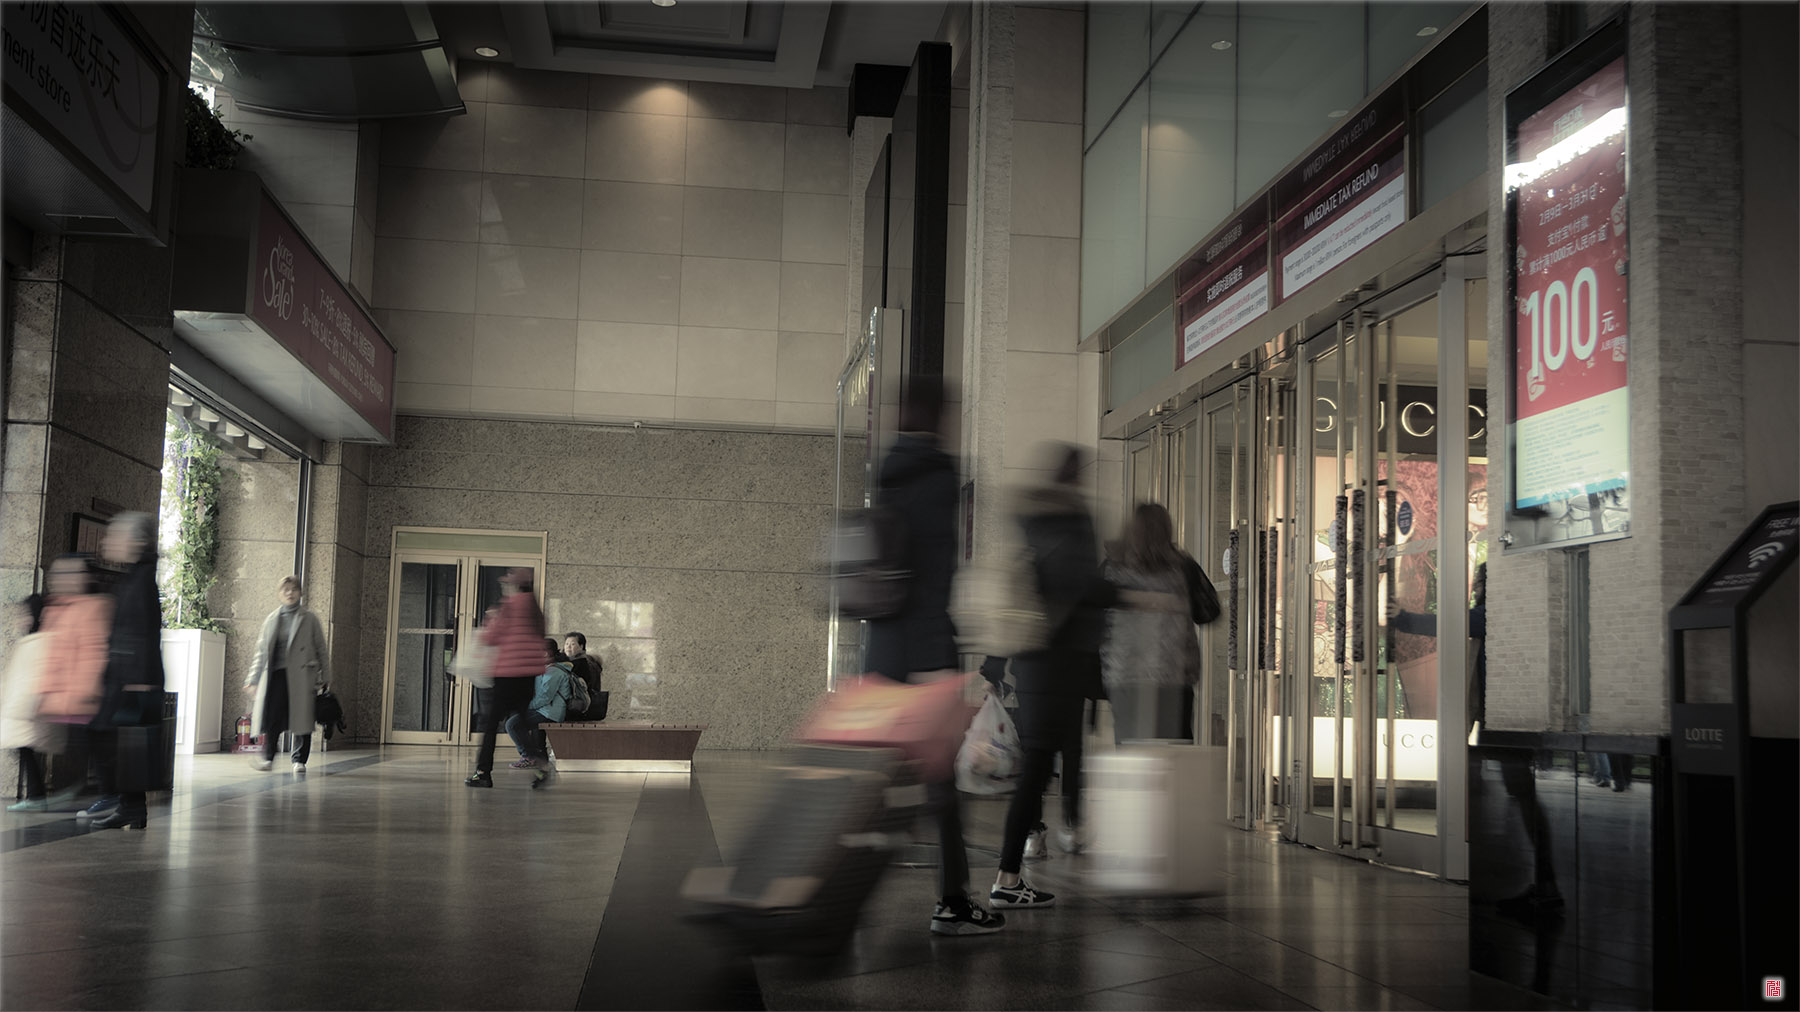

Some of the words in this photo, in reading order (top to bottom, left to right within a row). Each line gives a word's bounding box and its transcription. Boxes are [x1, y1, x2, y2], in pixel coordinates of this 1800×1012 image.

[20, 1, 120, 110] 物首选乐天
[37, 64, 71, 112] store
[1303, 192, 1338, 230] IMMEDIATE
[1338, 184, 1352, 206] TAX
[1351, 163, 1379, 196] REFUND
[262, 247, 294, 320] Sale
[1526, 266, 1598, 380] 100
[1684, 727, 1724, 742] LOTTE
